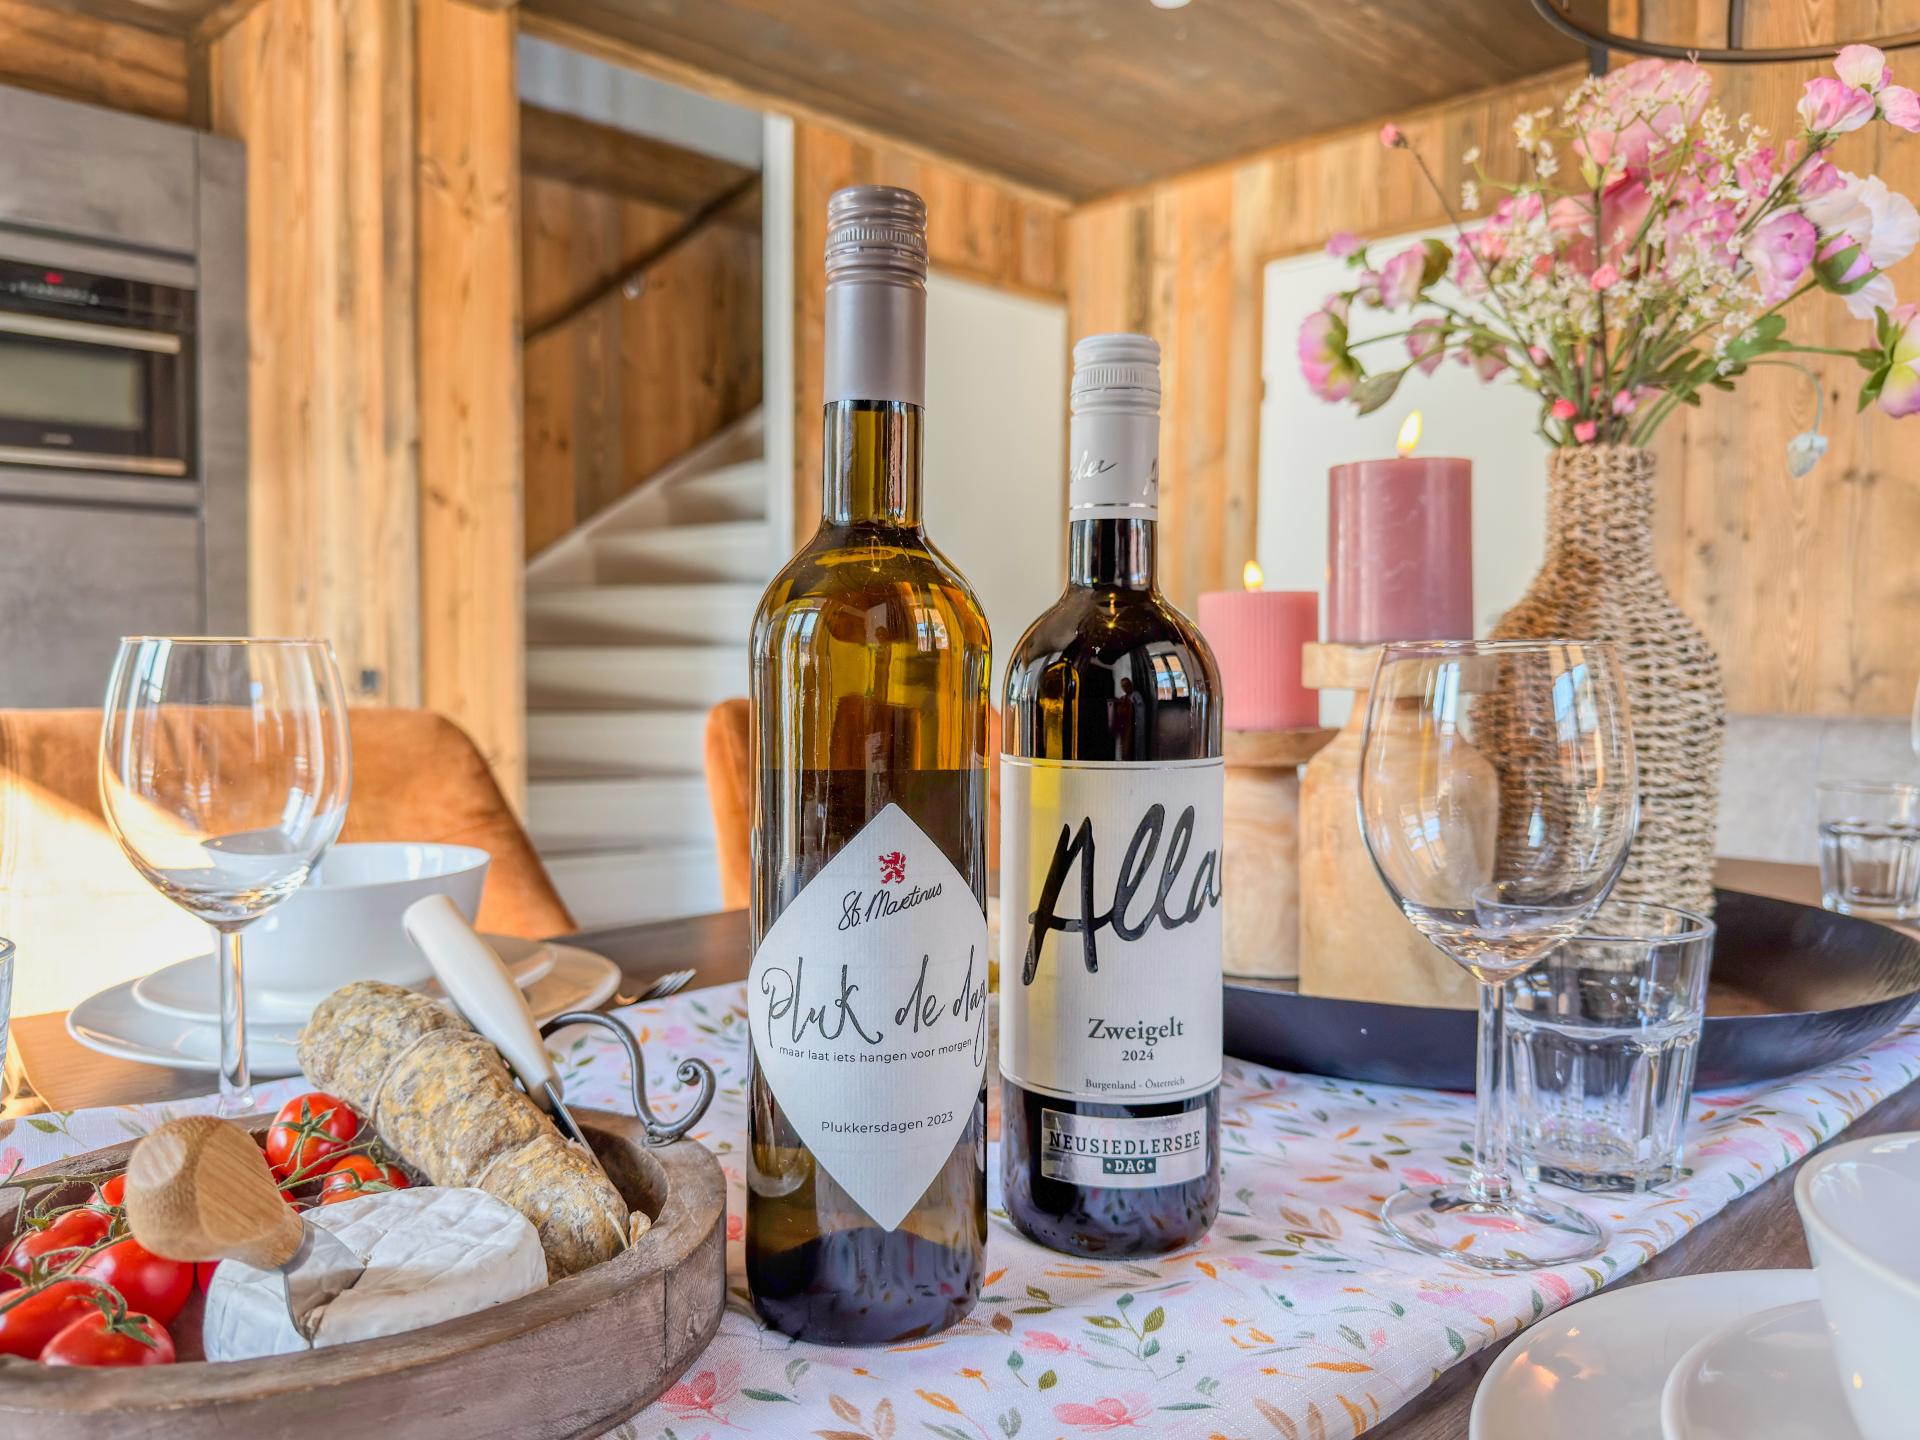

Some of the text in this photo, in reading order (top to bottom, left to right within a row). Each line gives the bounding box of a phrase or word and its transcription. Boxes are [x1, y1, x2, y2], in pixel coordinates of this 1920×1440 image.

[865, 882, 943, 922] Martinus
[761, 944, 988, 1068] Pluk de dag
[1087, 1016, 1184, 1046] Zweigelt
[779, 1037, 972, 1065] maar laat iets hangen voor morgen
[1121, 1048, 1154, 1062] 2024
[1085, 1078, 1136, 1092] Burgenland
[1144, 1075, 1185, 1090] Österreich
[821, 1111, 954, 1134] Plukkersdagen 2023
[1049, 1130, 1201, 1156] NEUSIEDLERSEE
